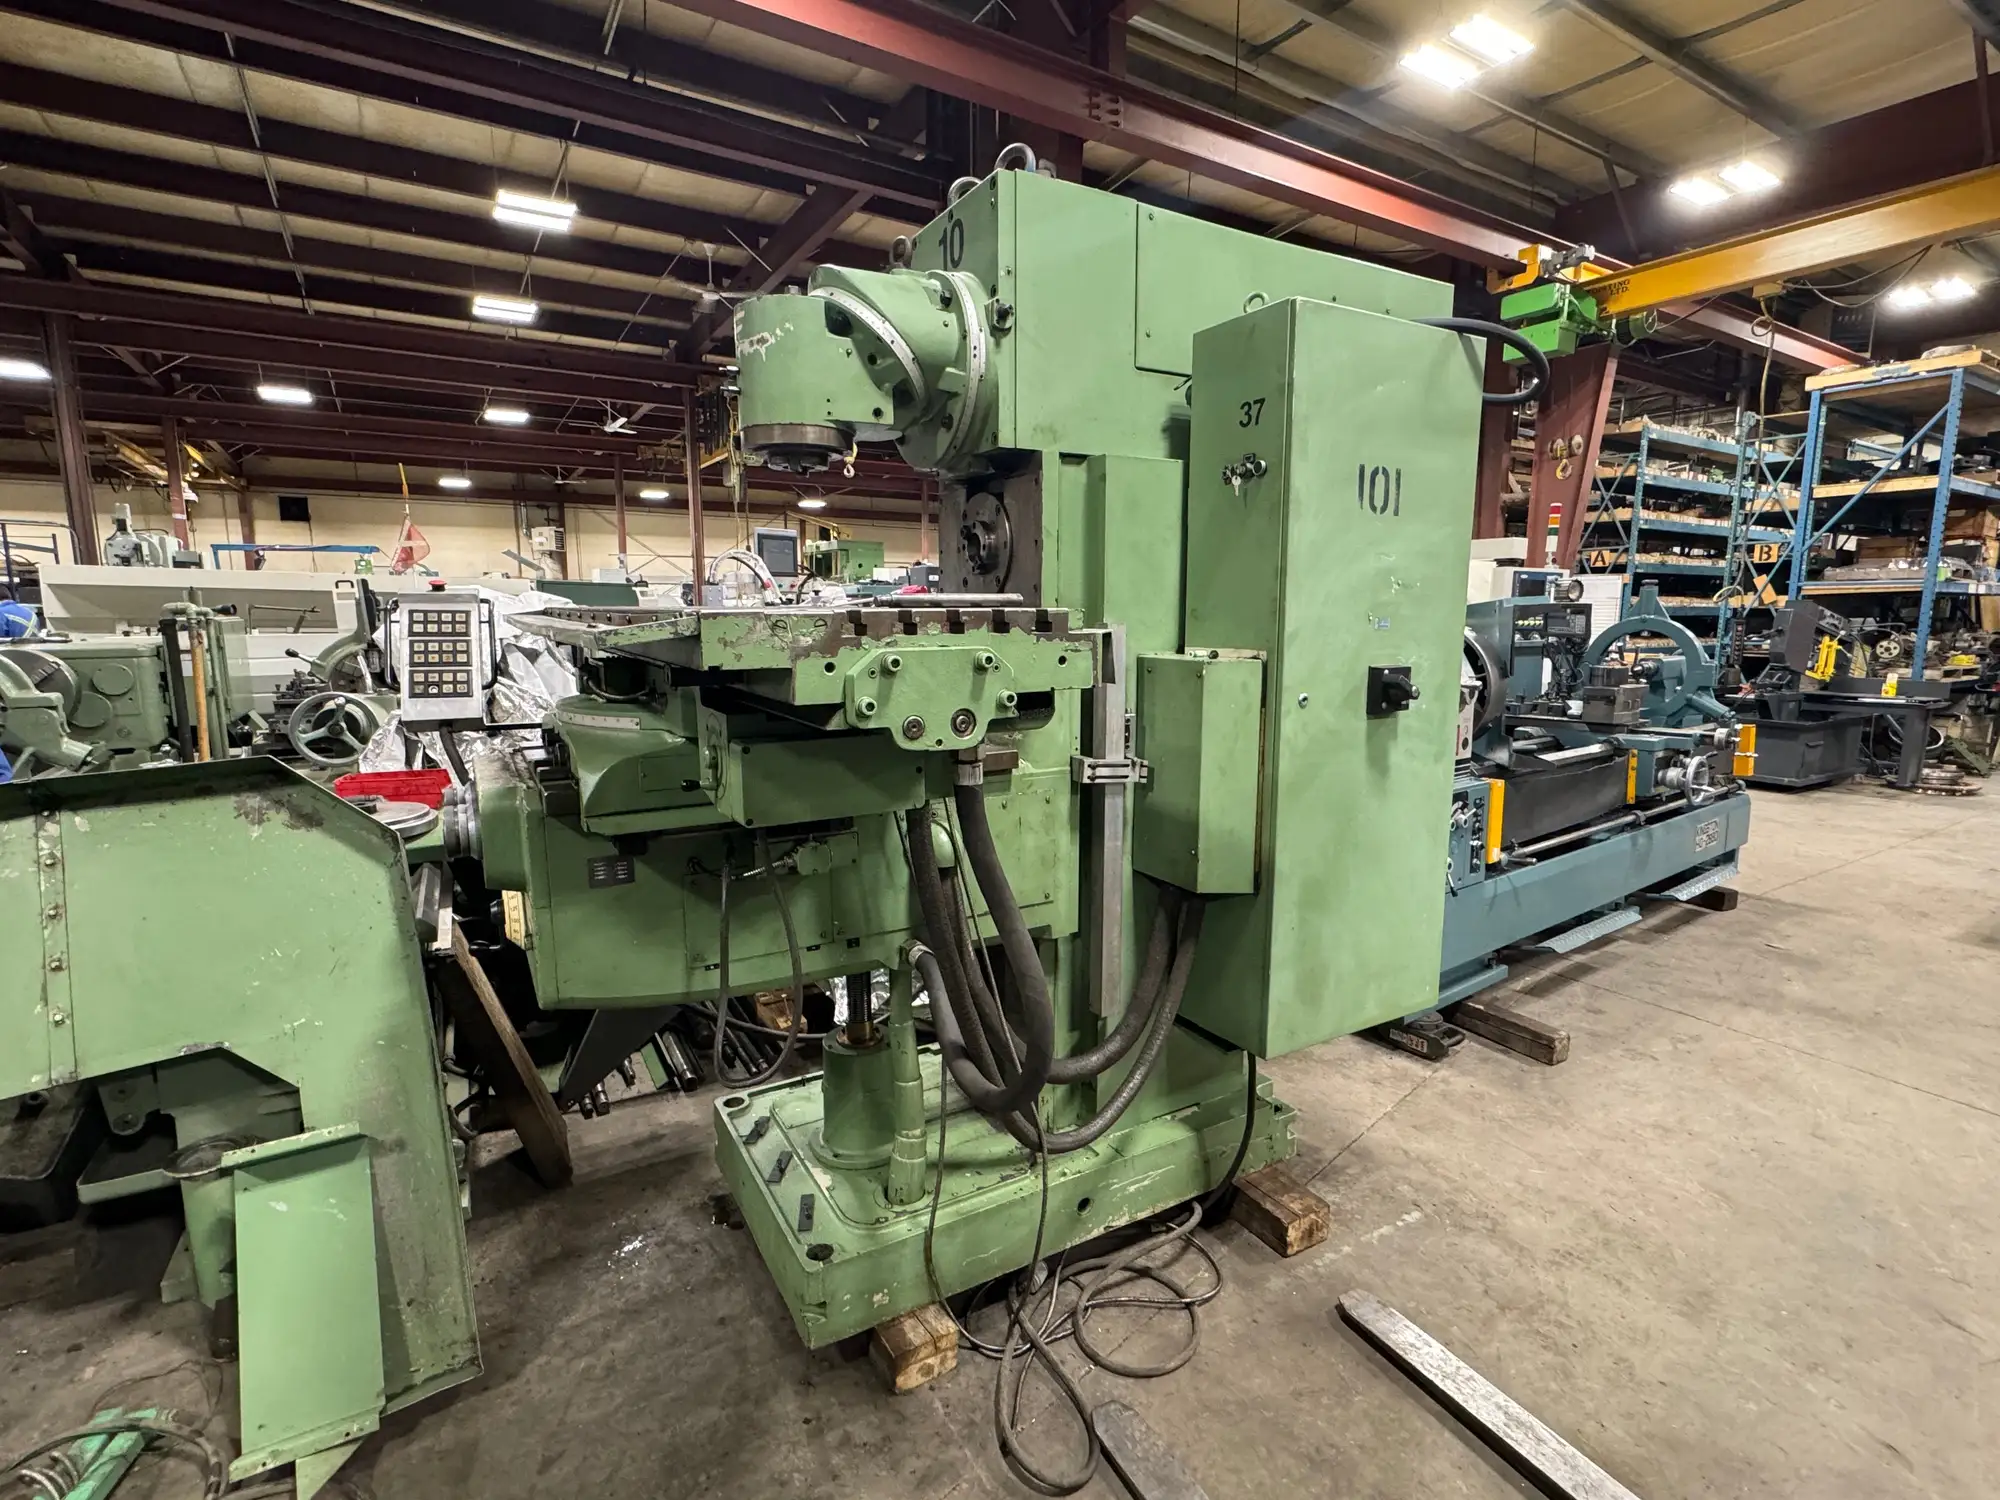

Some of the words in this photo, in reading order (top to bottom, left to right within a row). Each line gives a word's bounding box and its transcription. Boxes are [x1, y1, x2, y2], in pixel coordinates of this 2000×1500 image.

[938, 218, 964, 271] 10
[1239, 397, 1266, 428] 37
[1358, 463, 1402, 517] 101
[1591, 550, 1607, 566] A
[1758, 544, 1772, 561] B
